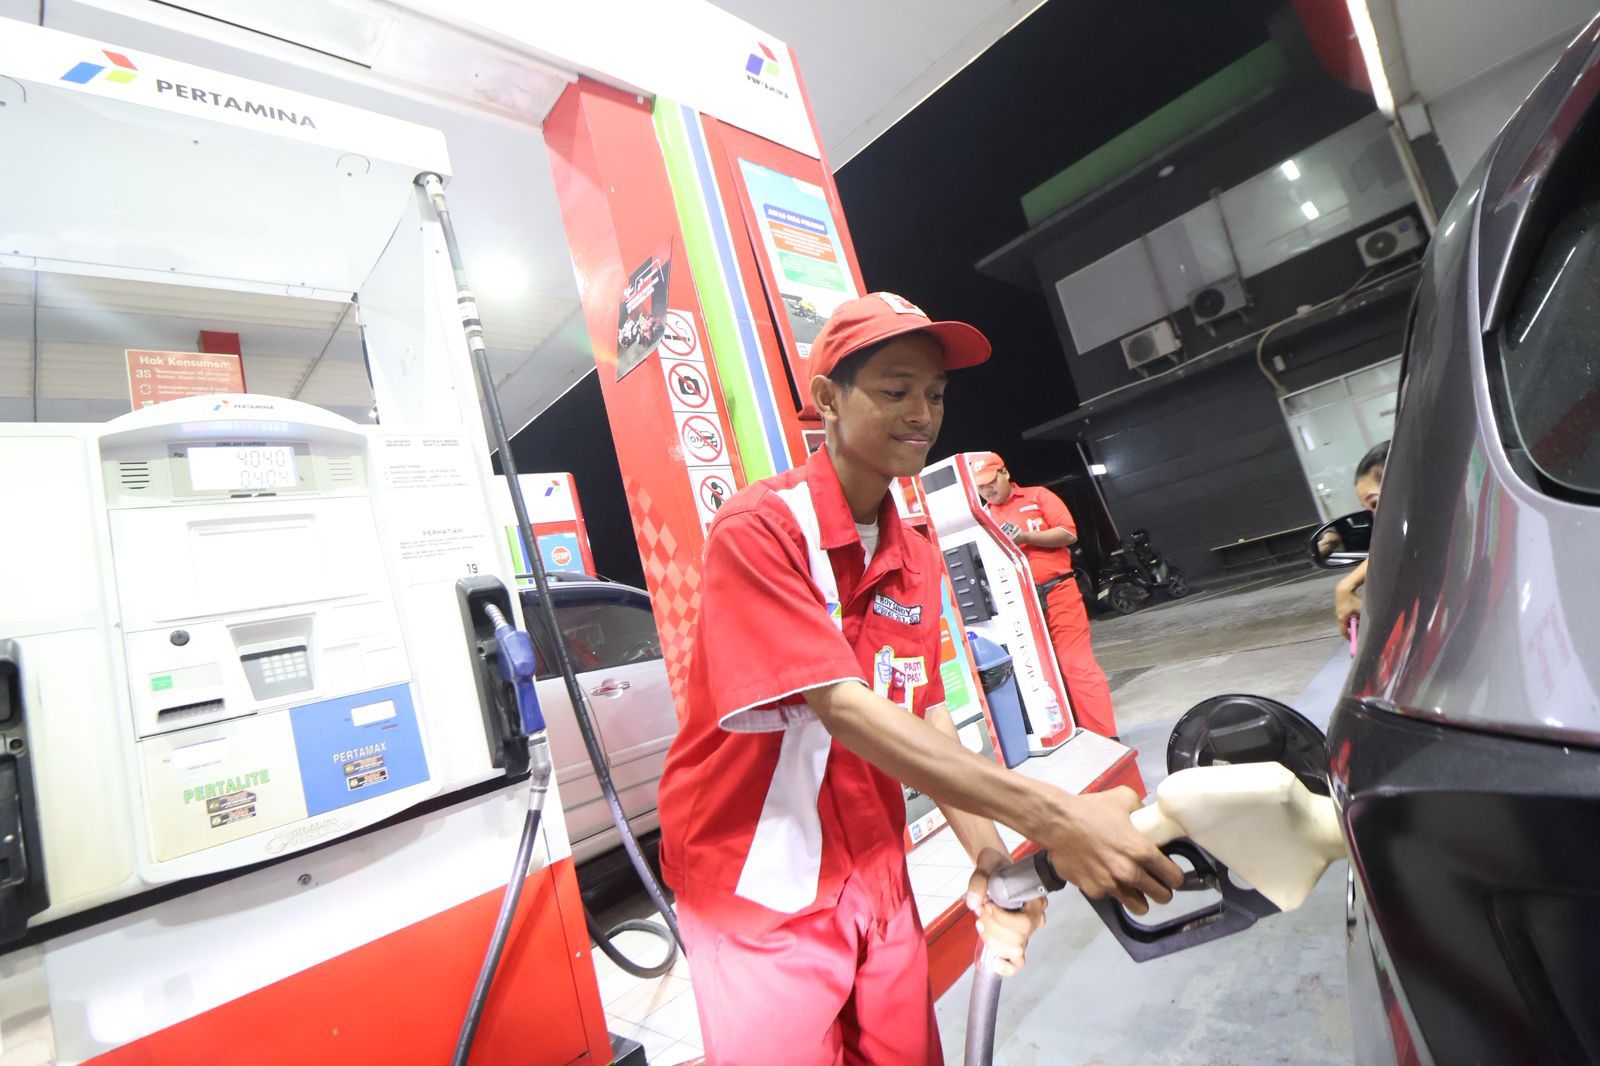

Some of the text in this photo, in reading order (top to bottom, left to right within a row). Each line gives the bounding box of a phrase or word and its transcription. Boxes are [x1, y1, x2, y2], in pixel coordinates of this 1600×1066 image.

[156, 79, 317, 129] PERTAMINA
[140, 356, 165, 366] Hak
[466, 563, 478, 574] 19
[904, 661, 922, 672] PASTI
[332, 741, 388, 764] PERTAMAX
[183, 769, 271, 805] PERTALITE
